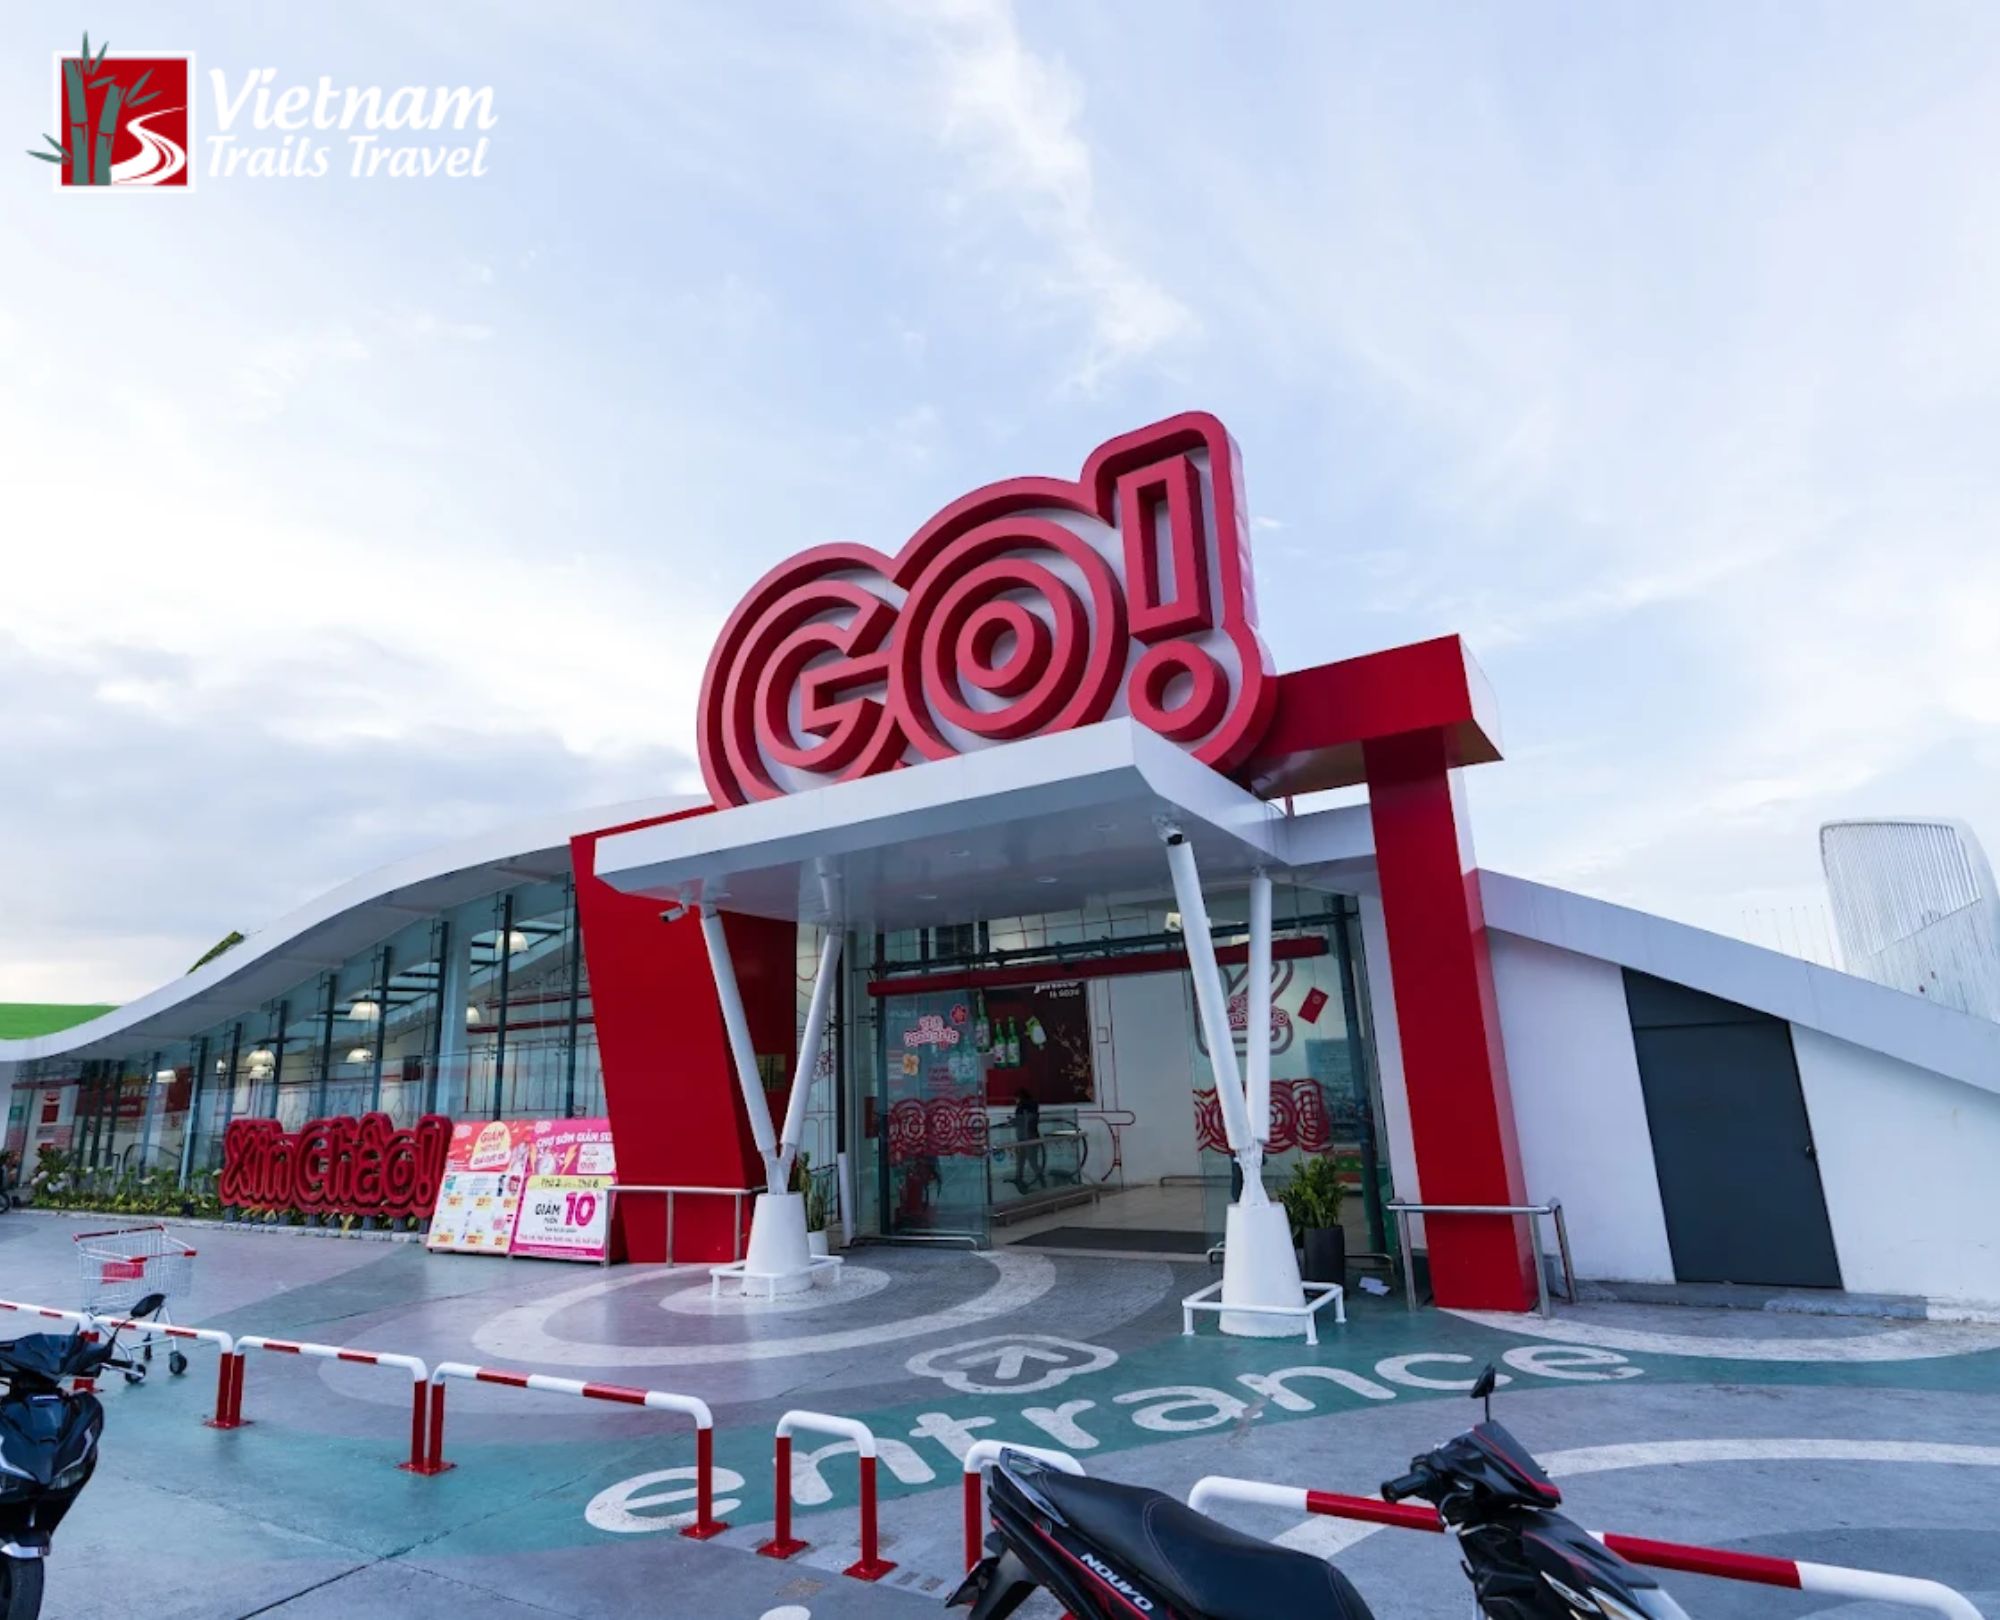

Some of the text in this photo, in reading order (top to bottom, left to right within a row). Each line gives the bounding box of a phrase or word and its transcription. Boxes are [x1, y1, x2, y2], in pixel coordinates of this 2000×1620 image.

[697, 411, 1272, 808] GO!
[584, 1343, 1645, 1535] entrance
[1080, 1552, 1154, 1612] NOUVO
